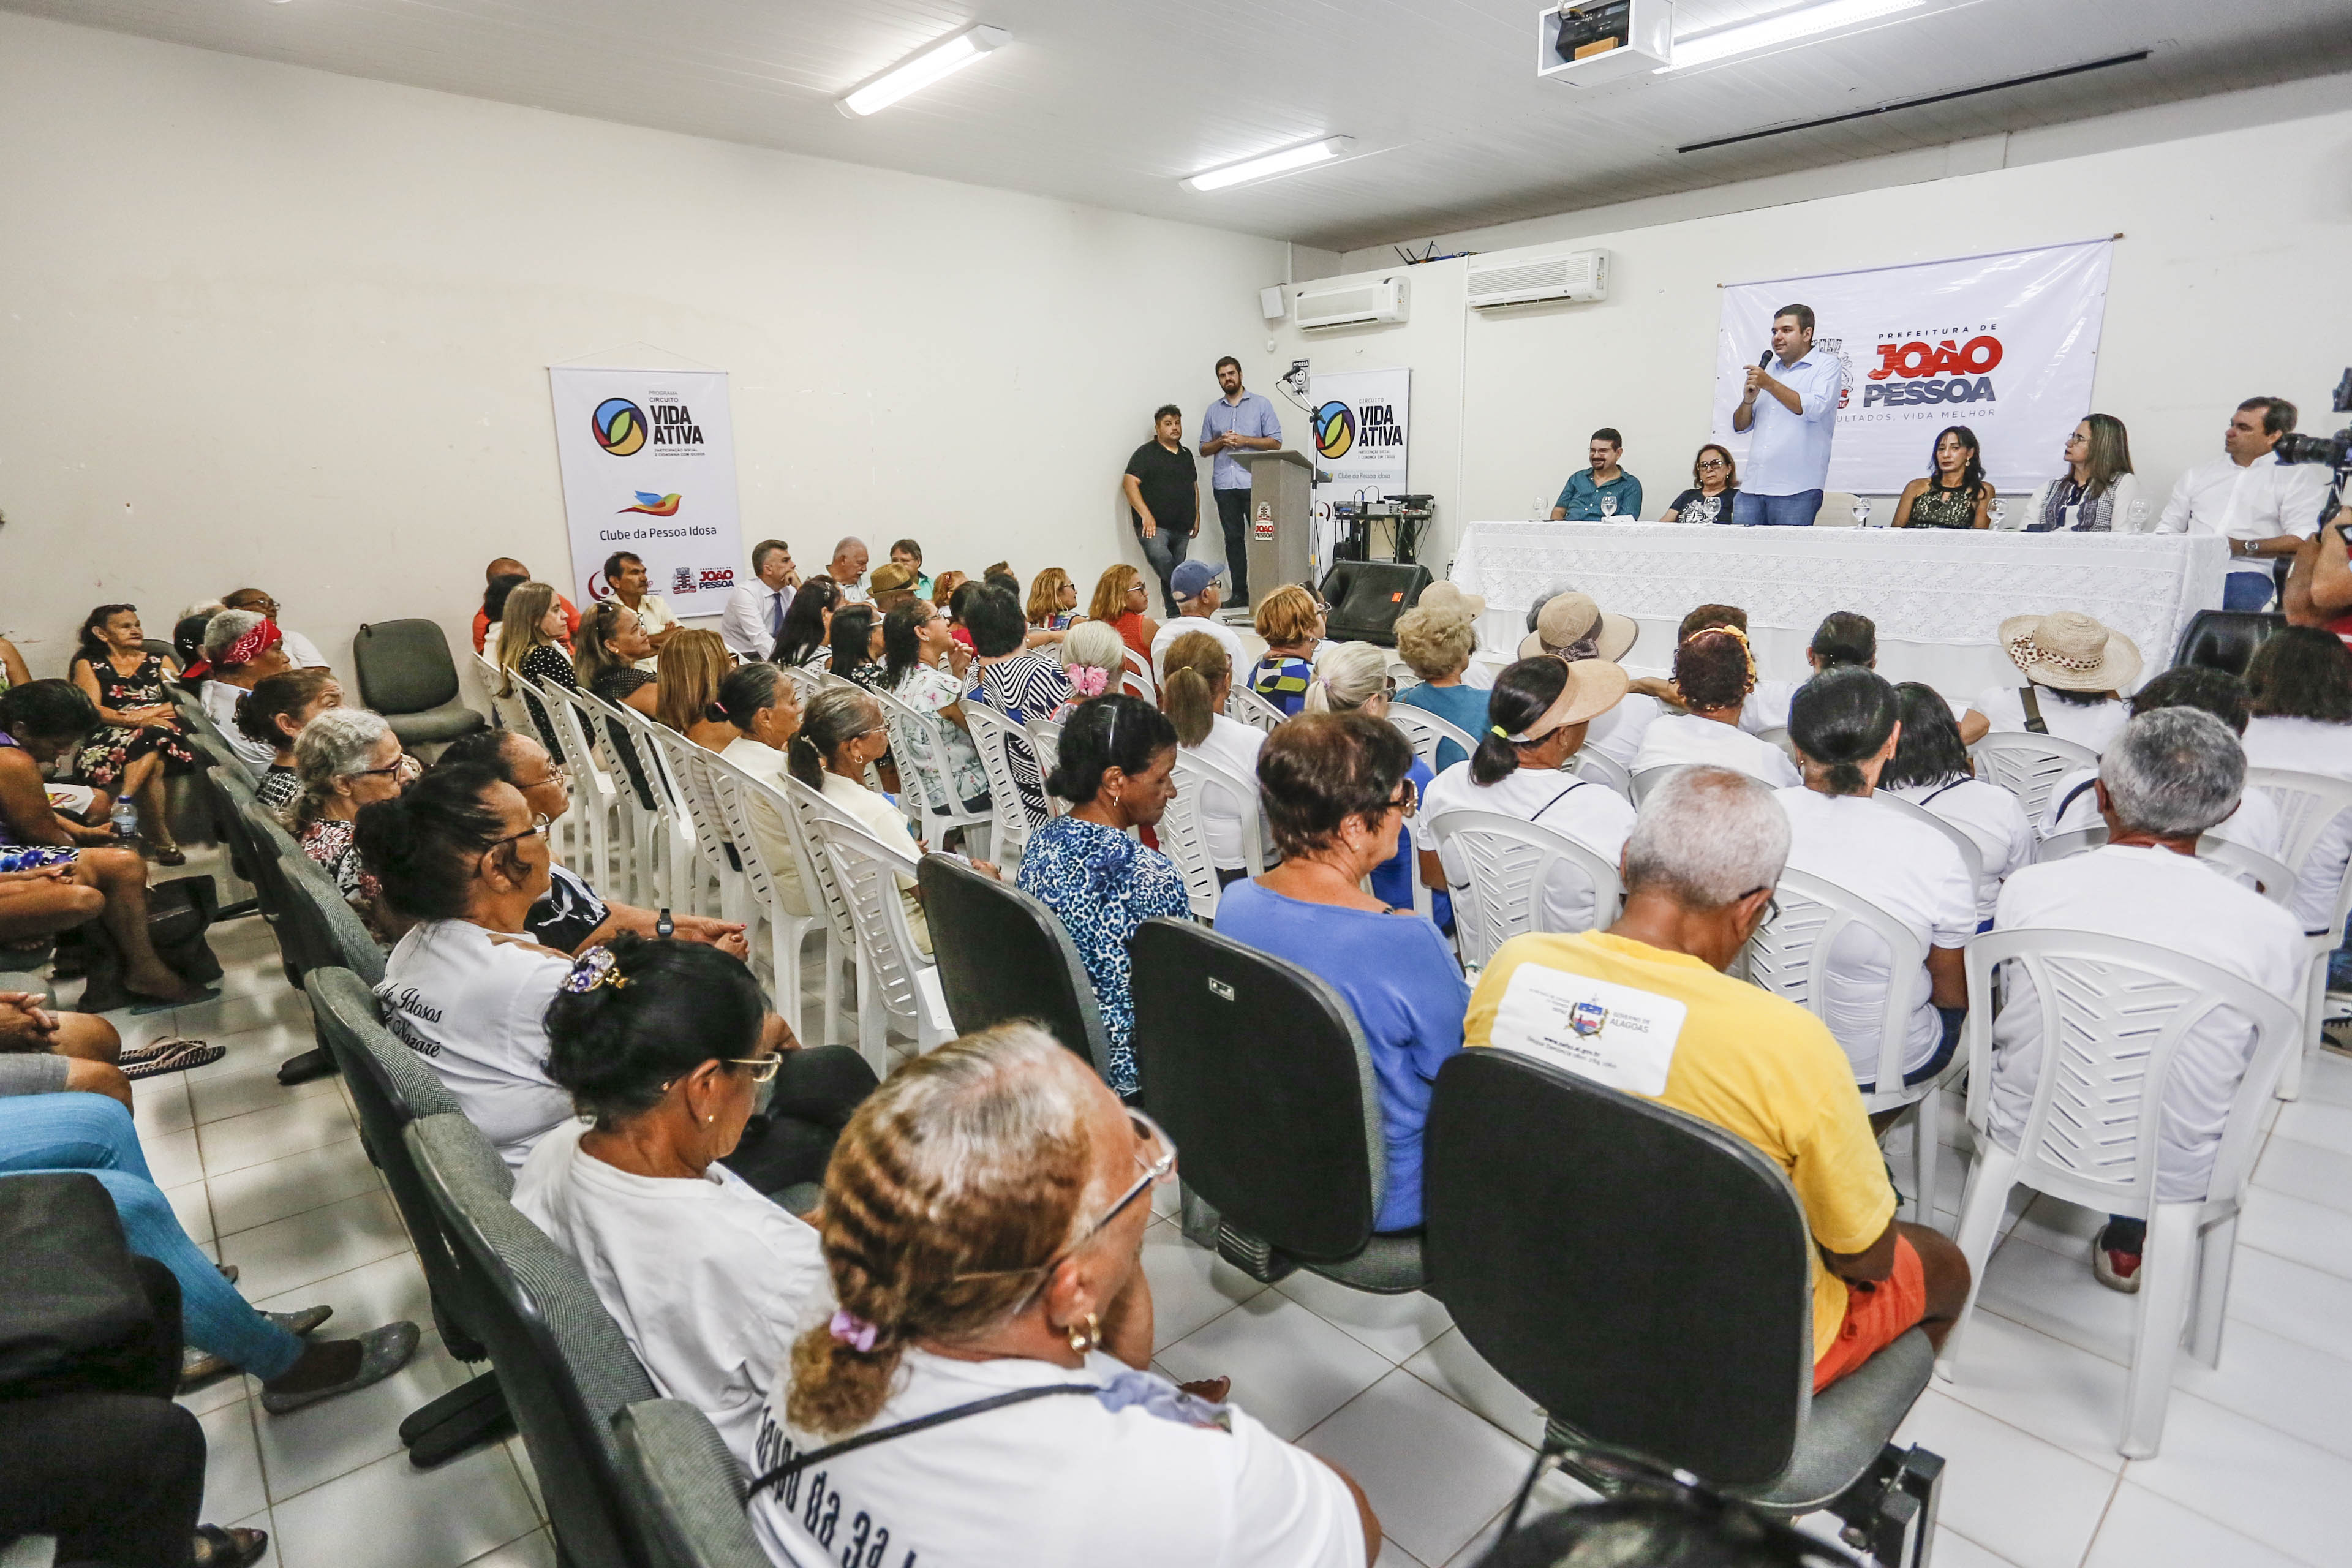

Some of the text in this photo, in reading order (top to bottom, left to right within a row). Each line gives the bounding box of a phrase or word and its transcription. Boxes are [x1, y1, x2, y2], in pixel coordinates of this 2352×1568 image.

[1879, 326, 1969, 339] PREFEITURA
[1866, 336, 2003, 380] JOÃO
[1863, 376, 1996, 407] PESSOA
[650, 405, 692, 424] VIDA
[1359, 405, 1393, 426] VIDA
[1836, 409, 1996, 423] ULTADOS, VIDA MELHOR
[654, 426, 704, 445] ATIVA
[1359, 426, 1403, 447] ATIVA
[600, 526, 717, 541] Clube da Pessoa Idosa
[699, 570, 733, 581] JOÃO
[699, 580, 734, 589] PESSOA
[396, 987, 442, 1023] Idosos
[1610, 1018, 1649, 1033] ALAGOAS
[393, 1019, 441, 1058] Nazaré
[803, 1470, 840, 1553] da
